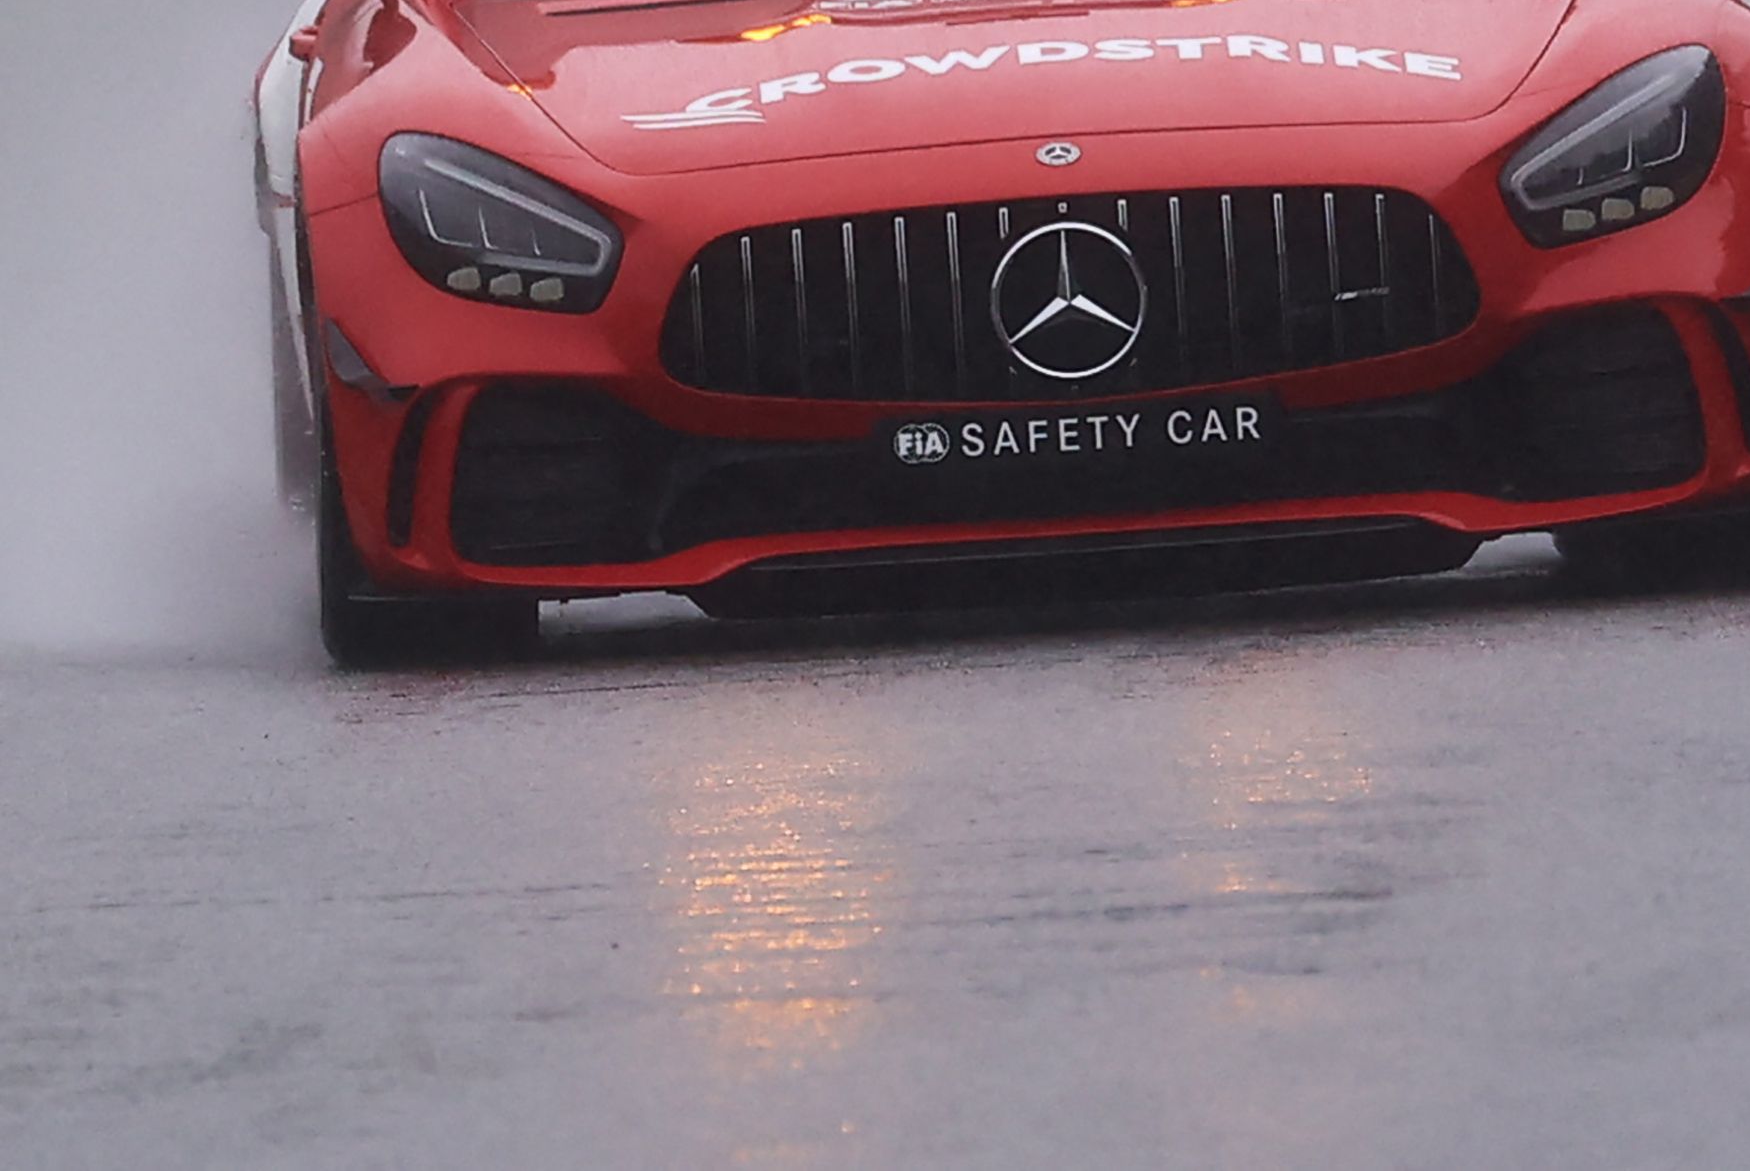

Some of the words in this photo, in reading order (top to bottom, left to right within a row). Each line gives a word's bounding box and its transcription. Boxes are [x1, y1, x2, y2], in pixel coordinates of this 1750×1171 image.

[683, 35, 1462, 114] CROWDSTRIKE
[961, 413, 1141, 457] SAFETY
[1167, 406, 1261, 444] CAR
